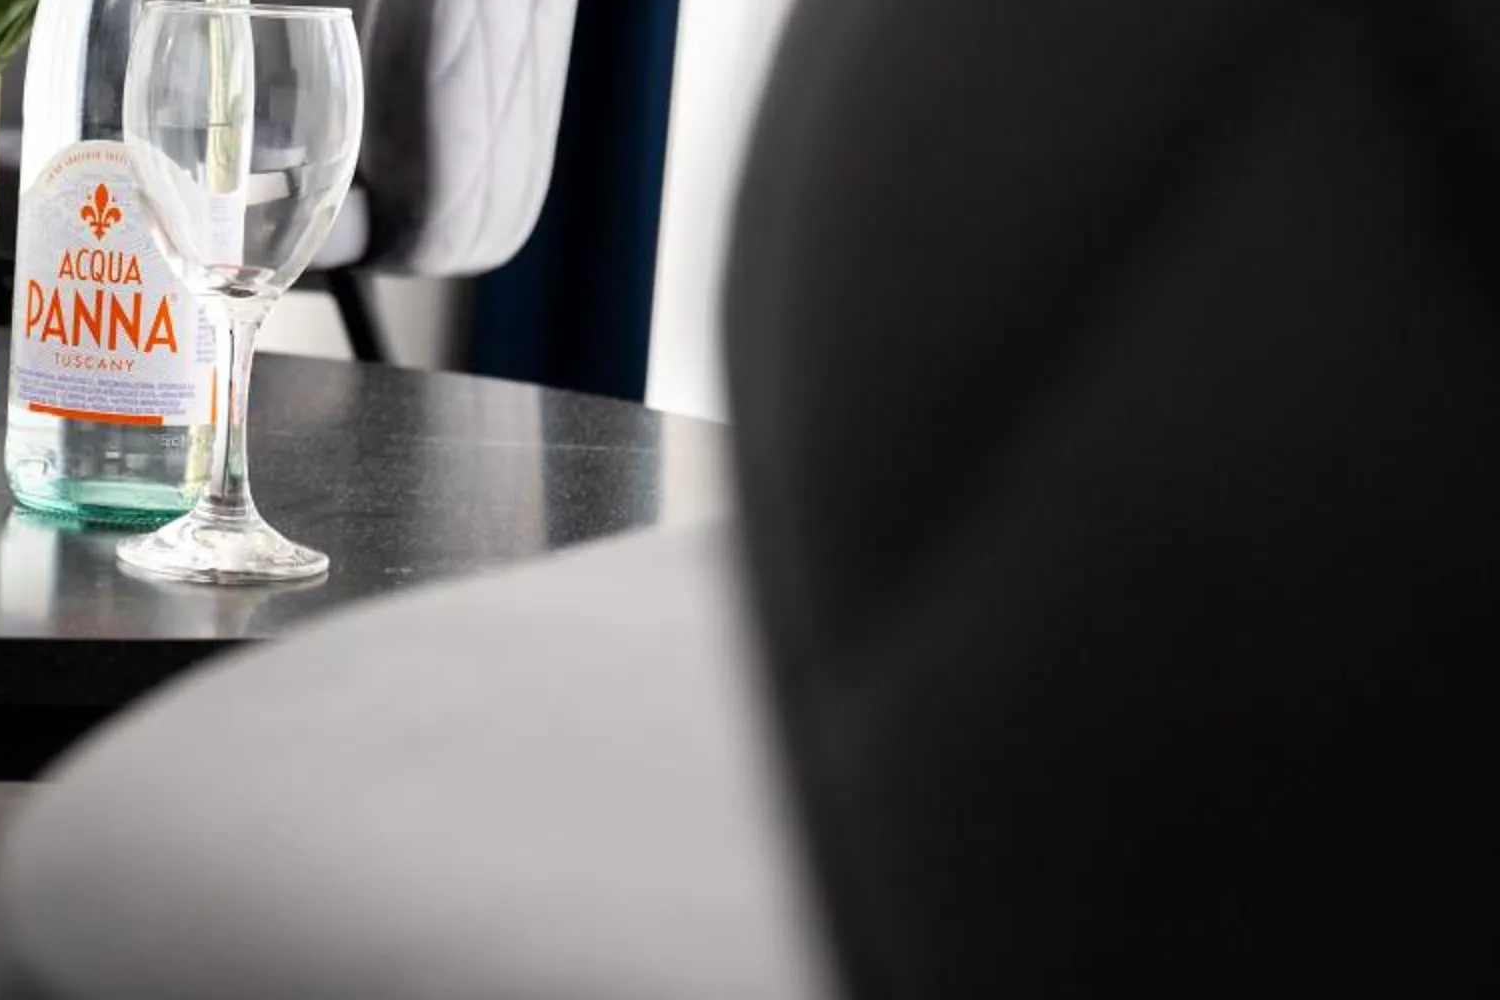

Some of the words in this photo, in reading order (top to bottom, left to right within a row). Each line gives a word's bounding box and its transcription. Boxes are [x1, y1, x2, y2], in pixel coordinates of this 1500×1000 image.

[57, 247, 143, 285] ACQUA
[24, 278, 178, 353] PANNA
[54, 352, 137, 373] TUSCANY
